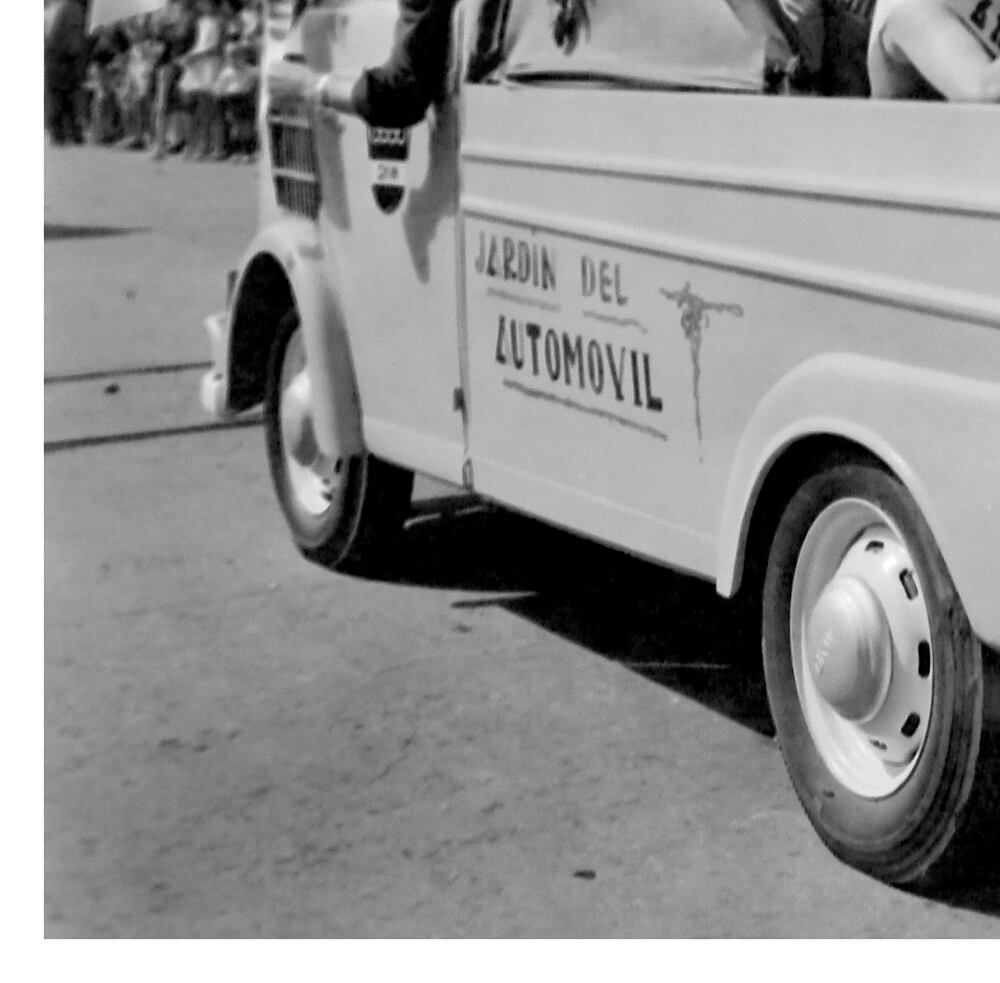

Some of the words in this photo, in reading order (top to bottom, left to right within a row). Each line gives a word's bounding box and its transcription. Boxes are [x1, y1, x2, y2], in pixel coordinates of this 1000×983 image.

[475, 231, 556, 290] JARDIN
[581, 254, 629, 306] DEL
[495, 315, 663, 412] AUTOMOVIL
